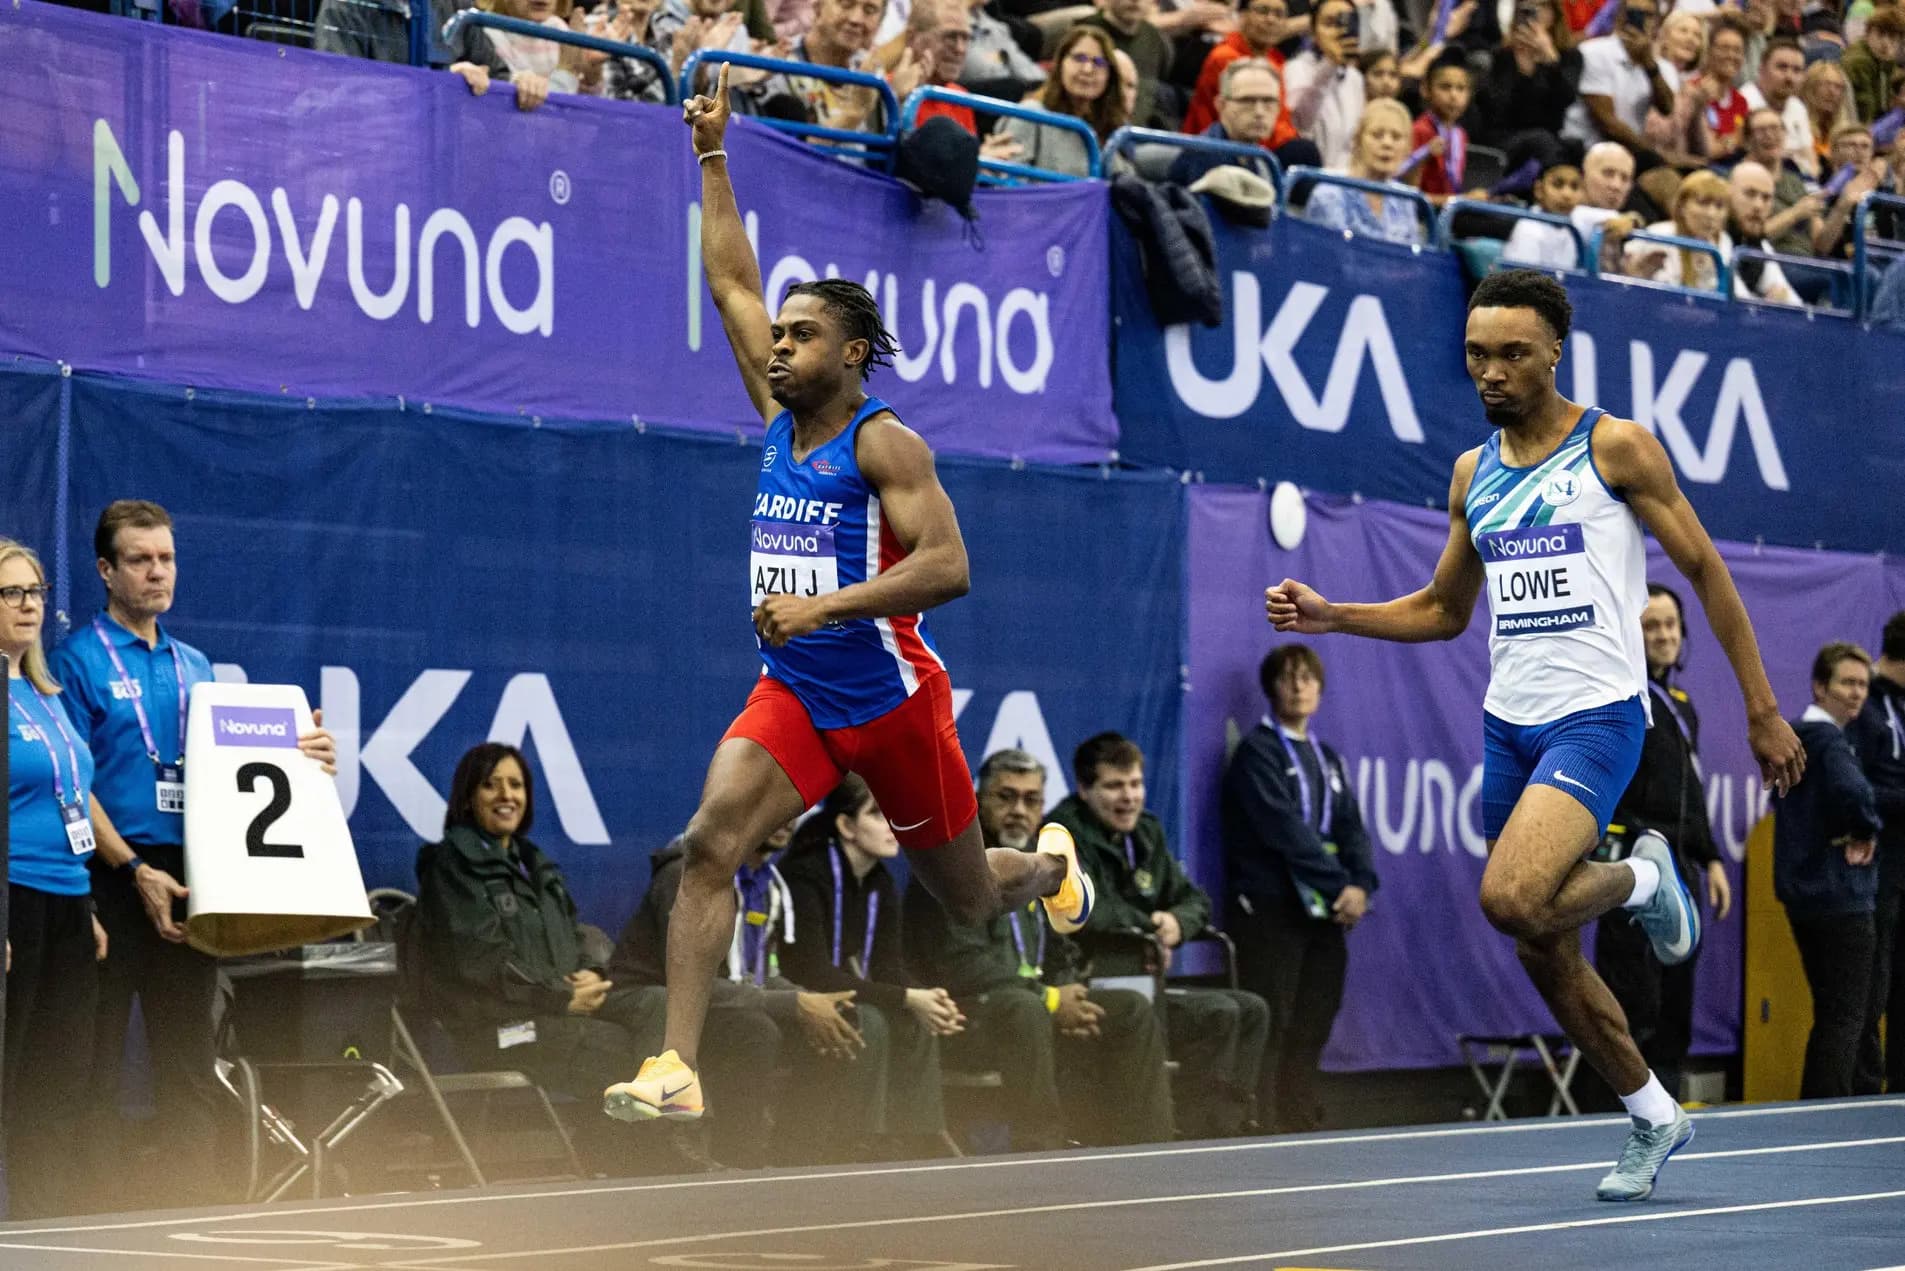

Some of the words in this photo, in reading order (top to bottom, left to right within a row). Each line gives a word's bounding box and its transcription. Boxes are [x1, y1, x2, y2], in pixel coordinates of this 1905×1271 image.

[755, 565, 796, 595] AZU
[805, 569, 818, 597] J
[1499, 567, 1571, 602] LOWE
[236, 761, 304, 858] 2
